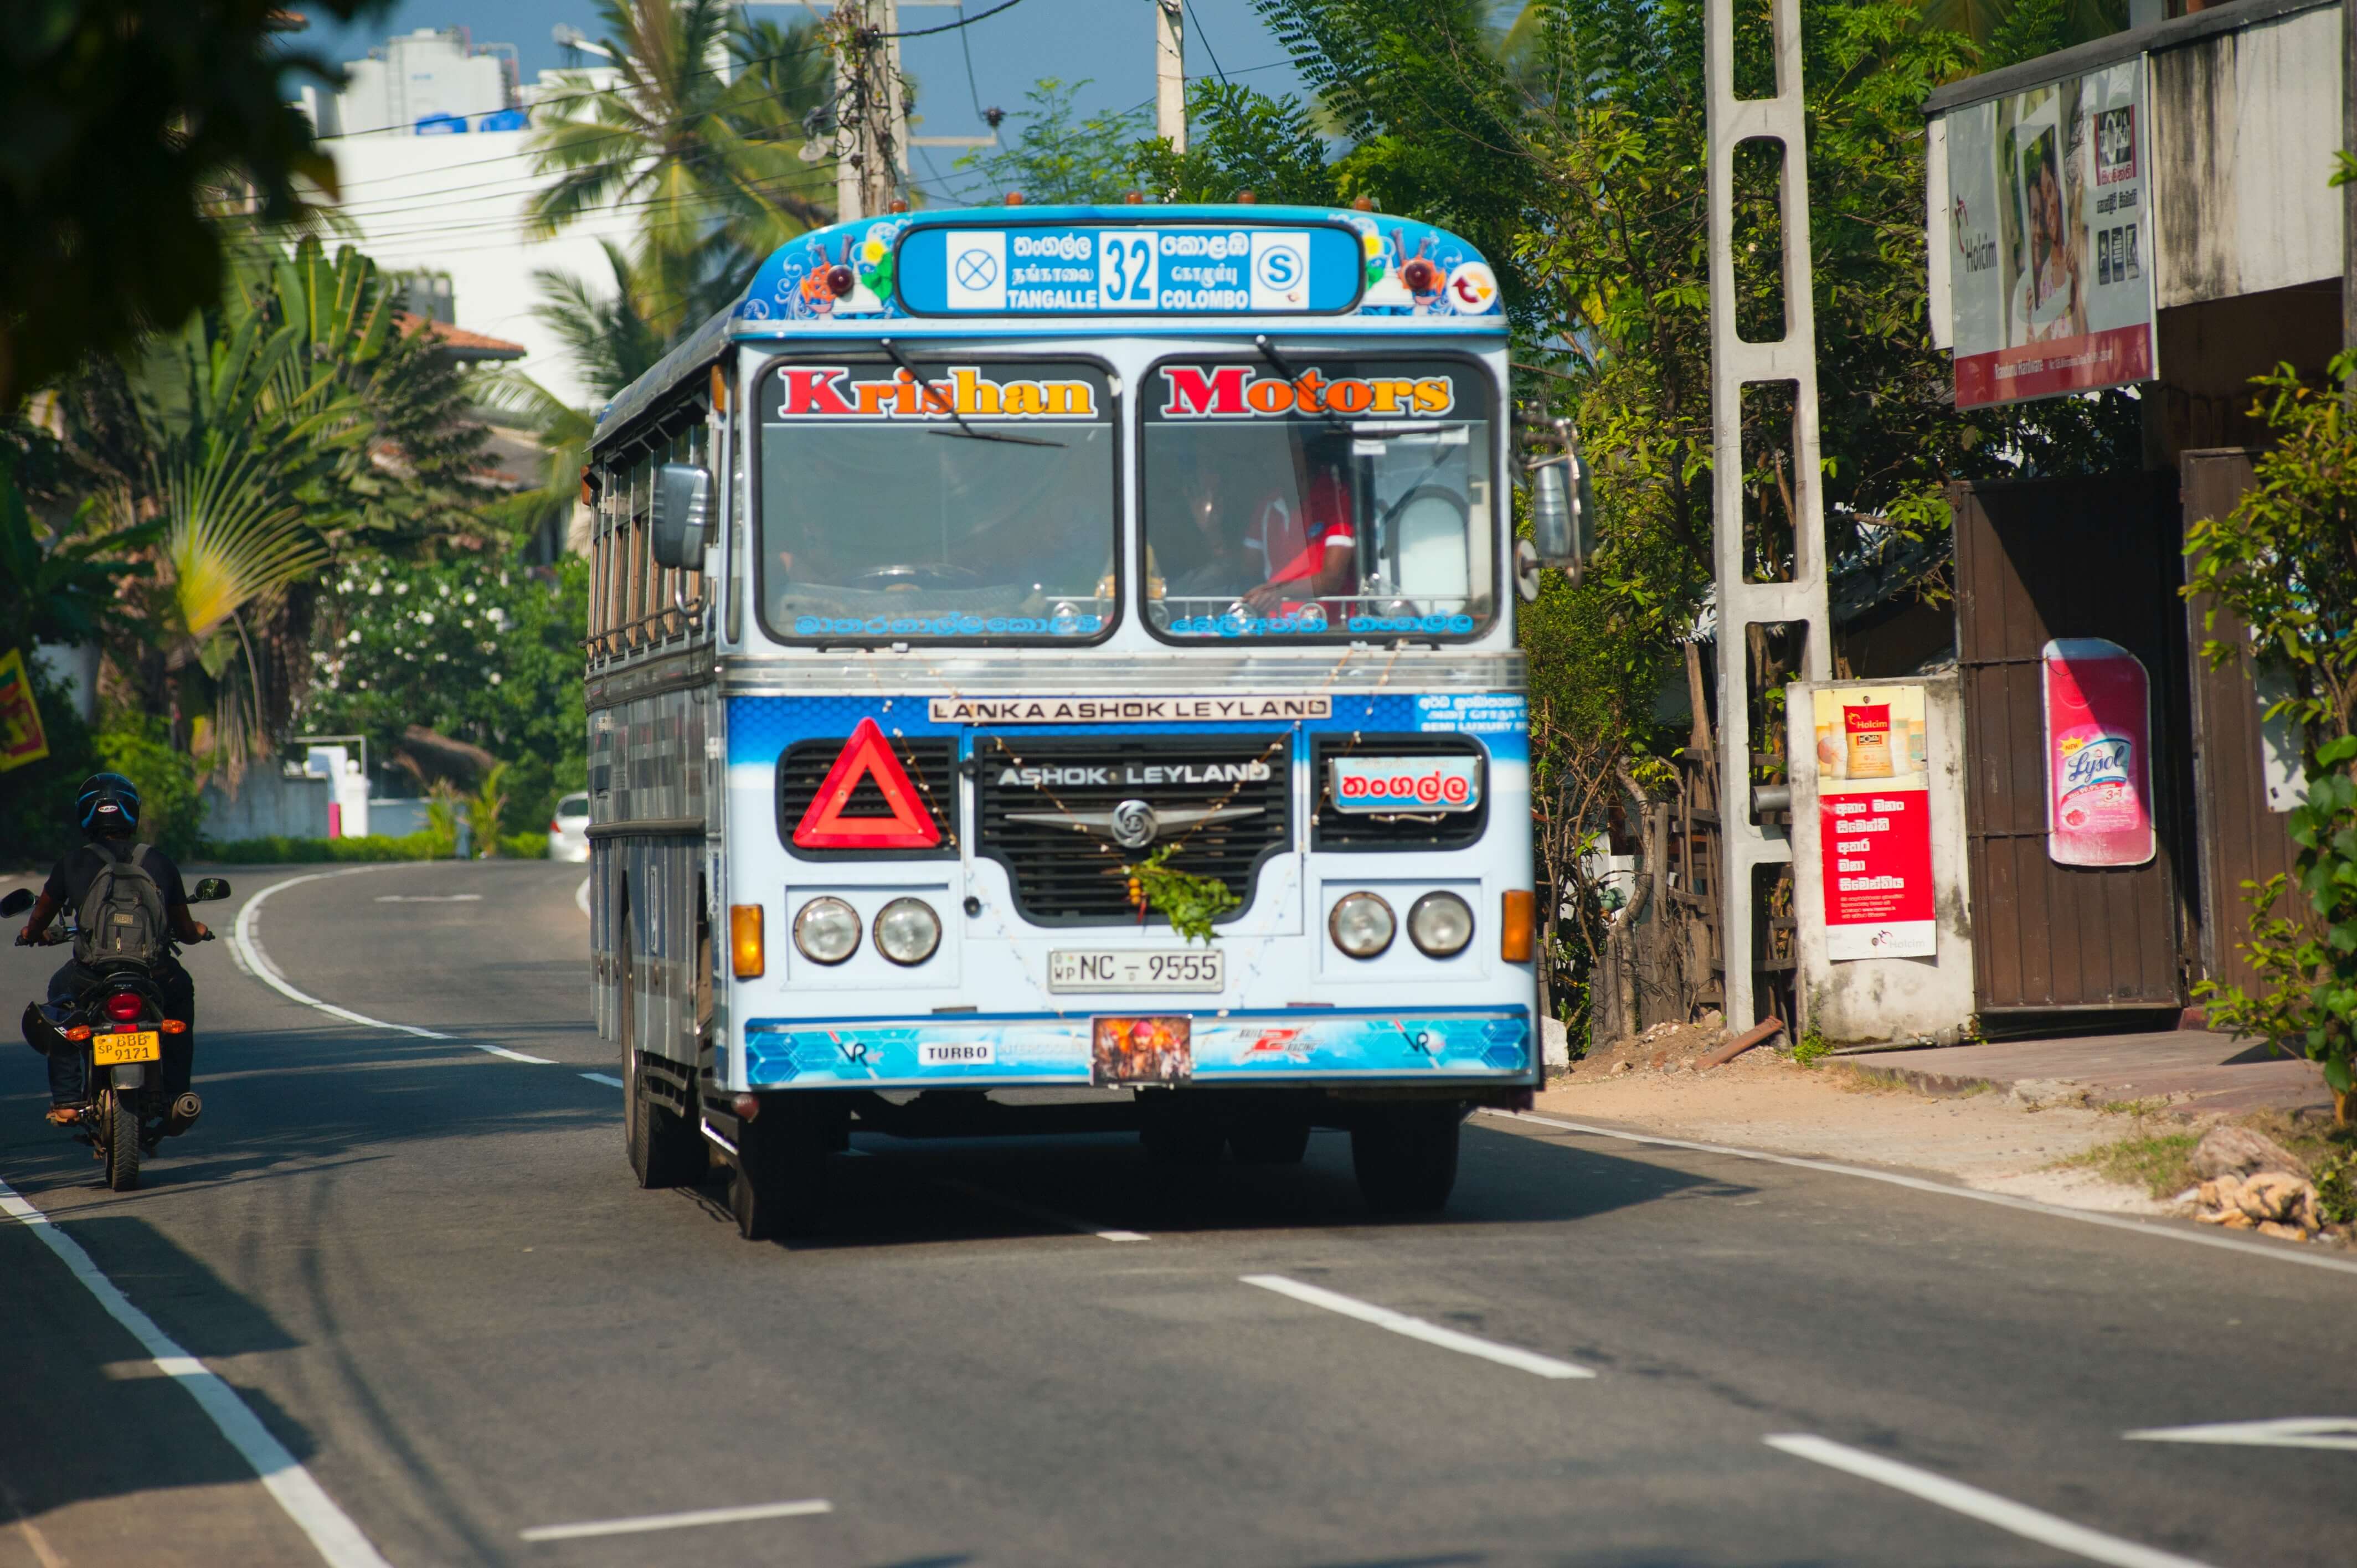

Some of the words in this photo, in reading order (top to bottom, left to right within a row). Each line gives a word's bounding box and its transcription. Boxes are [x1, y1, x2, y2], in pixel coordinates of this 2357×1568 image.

[1160, 232, 1250, 260] කොළඹ
[1966, 232, 1997, 273] Holcim
[1107, 239, 1150, 301] 32
[1268, 254, 1291, 282] S
[1007, 289, 1098, 309] TANGALLE
[1160, 289, 1249, 310] COLOMBO
[2018, 357, 2044, 376] Hardware
[779, 367, 1097, 418] Krishan
[1162, 367, 1453, 416] Motors
[794, 615, 888, 636] මාතර
[934, 704, 1045, 719] LANKA
[1054, 702, 1165, 718] ASHOK
[1175, 700, 1327, 717] LEYLAND
[1458, 721, 1513, 732] LUXURY
[1856, 720, 1887, 729] Holcim
[997, 767, 1108, 785] ASHOK
[1126, 763, 1271, 784] LEYLAND
[2068, 745, 2124, 783] Lysol
[1341, 771, 1469, 802] තංගල්ල
[1890, 939, 1925, 948] Holcim
[1054, 967, 1075, 980] WP
[1080, 955, 1115, 980] NC
[1149, 955, 1217, 981] 9555
[98, 1045, 113, 1054] SP
[115, 1047, 150, 1060] 9171
[928, 1046, 988, 1060] TURBO
